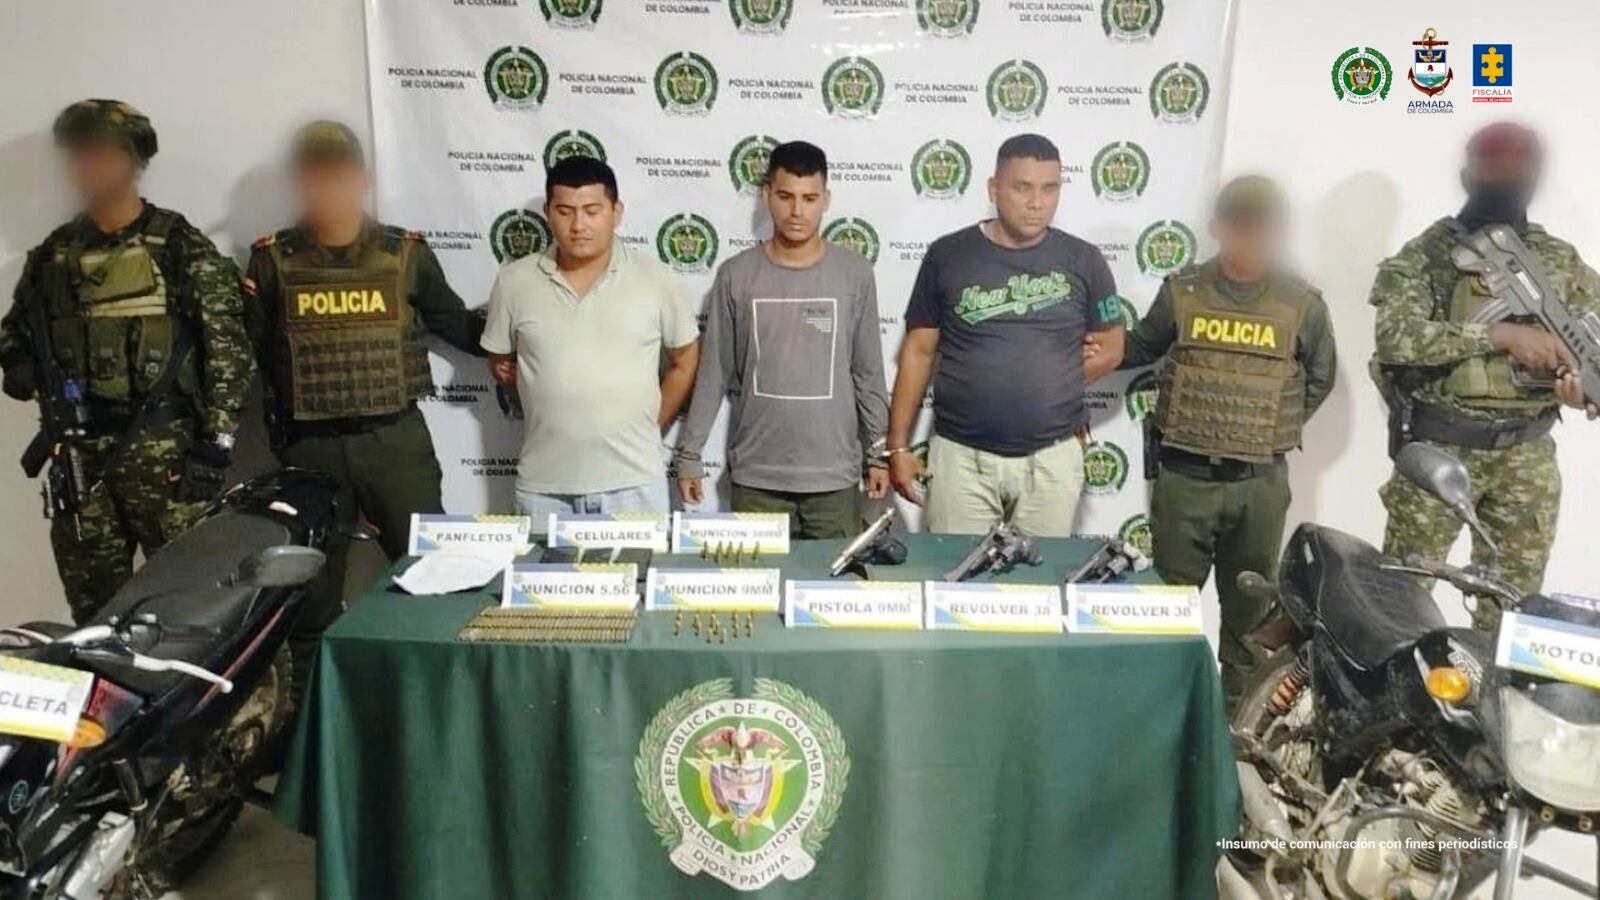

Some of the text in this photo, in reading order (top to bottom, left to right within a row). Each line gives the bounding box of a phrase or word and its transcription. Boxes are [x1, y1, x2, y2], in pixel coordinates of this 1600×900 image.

[660, 5, 710, 14] COLOMBIA
[1008, 2, 1094, 12] POLICIA NACIONAL
[1020, 14, 1082, 23] DE COLOMBIA
[388, 68, 477, 78] POLICIA NACIONAL
[560, 73, 647, 84] POLICIA NACIONAL
[402, 80, 464, 90] DE COLOMBIA
[728, 79, 814, 89] POLICIA NACIONAL
[894, 83, 978, 92] POLICIA NACIONAL
[571, 86, 635, 95] DE COLOMBIA
[740, 91, 803, 100] DE COLOMBIA
[1058, 86, 1142, 95] POLICIA NACIONAL
[906, 95, 967, 104] DE COLOMBIA
[1068, 97, 1130, 106] DE COLOMBIA
[448, 152, 535, 162] POLICIA NACIONAL
[636, 157, 722, 167] POLICIA NACIONAL
[460, 163, 524, 172] DE COLOMBIA
[826, 162, 904, 172] OLICIA NACIONAL
[648, 169, 710, 178] DE COLOMBIA
[831, 174, 892, 182] DE COLOMBIA
[436, 231, 482, 240] NACIONAL
[430, 242, 472, 250] OLOMBIA
[890, 242, 924, 250] POLICIA
[900, 253, 912, 261] DE
[297, 290, 387, 315] POLICIA
[954, 285, 1009, 314] New
[1192, 317, 1276, 348] POLICIA
[436, 532, 512, 542] PANFLETOS
[575, 531, 651, 541] CELULARES
[690, 528, 747, 538] MUNICION
[522, 584, 630, 595] MUNICION 5.56
[665, 584, 773, 594] MUNICION 9MM
[808, 602, 872, 613] PISTOLA
[950, 603, 1050, 616] REVOLVER 38
[1092, 604, 1170, 616] REVOLVER
[664, 702, 822, 790] REPUBLICA DE COLOMBIA
[675, 805, 812, 866] POLICIA NACIONAL
